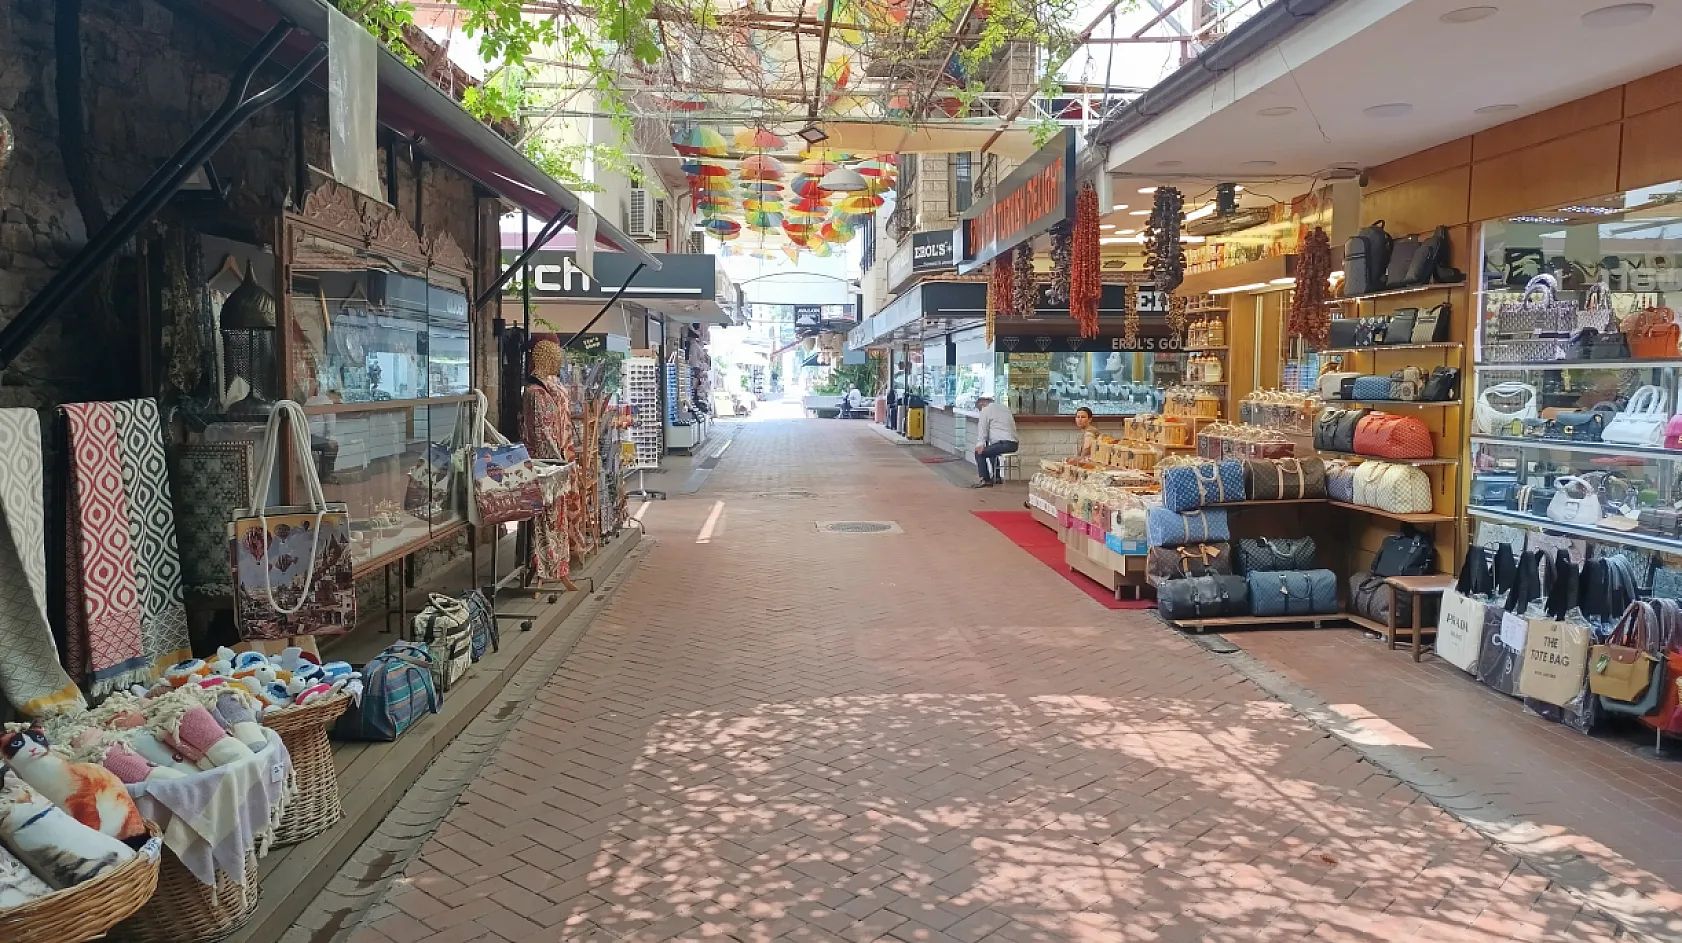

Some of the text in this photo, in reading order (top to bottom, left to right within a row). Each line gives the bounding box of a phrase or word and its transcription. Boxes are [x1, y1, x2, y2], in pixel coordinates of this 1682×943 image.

[1026, 156, 1062, 224] DELIGHT
[1544, 635, 1559, 649] THE
[1531, 649, 1570, 667] TOTE BAG
